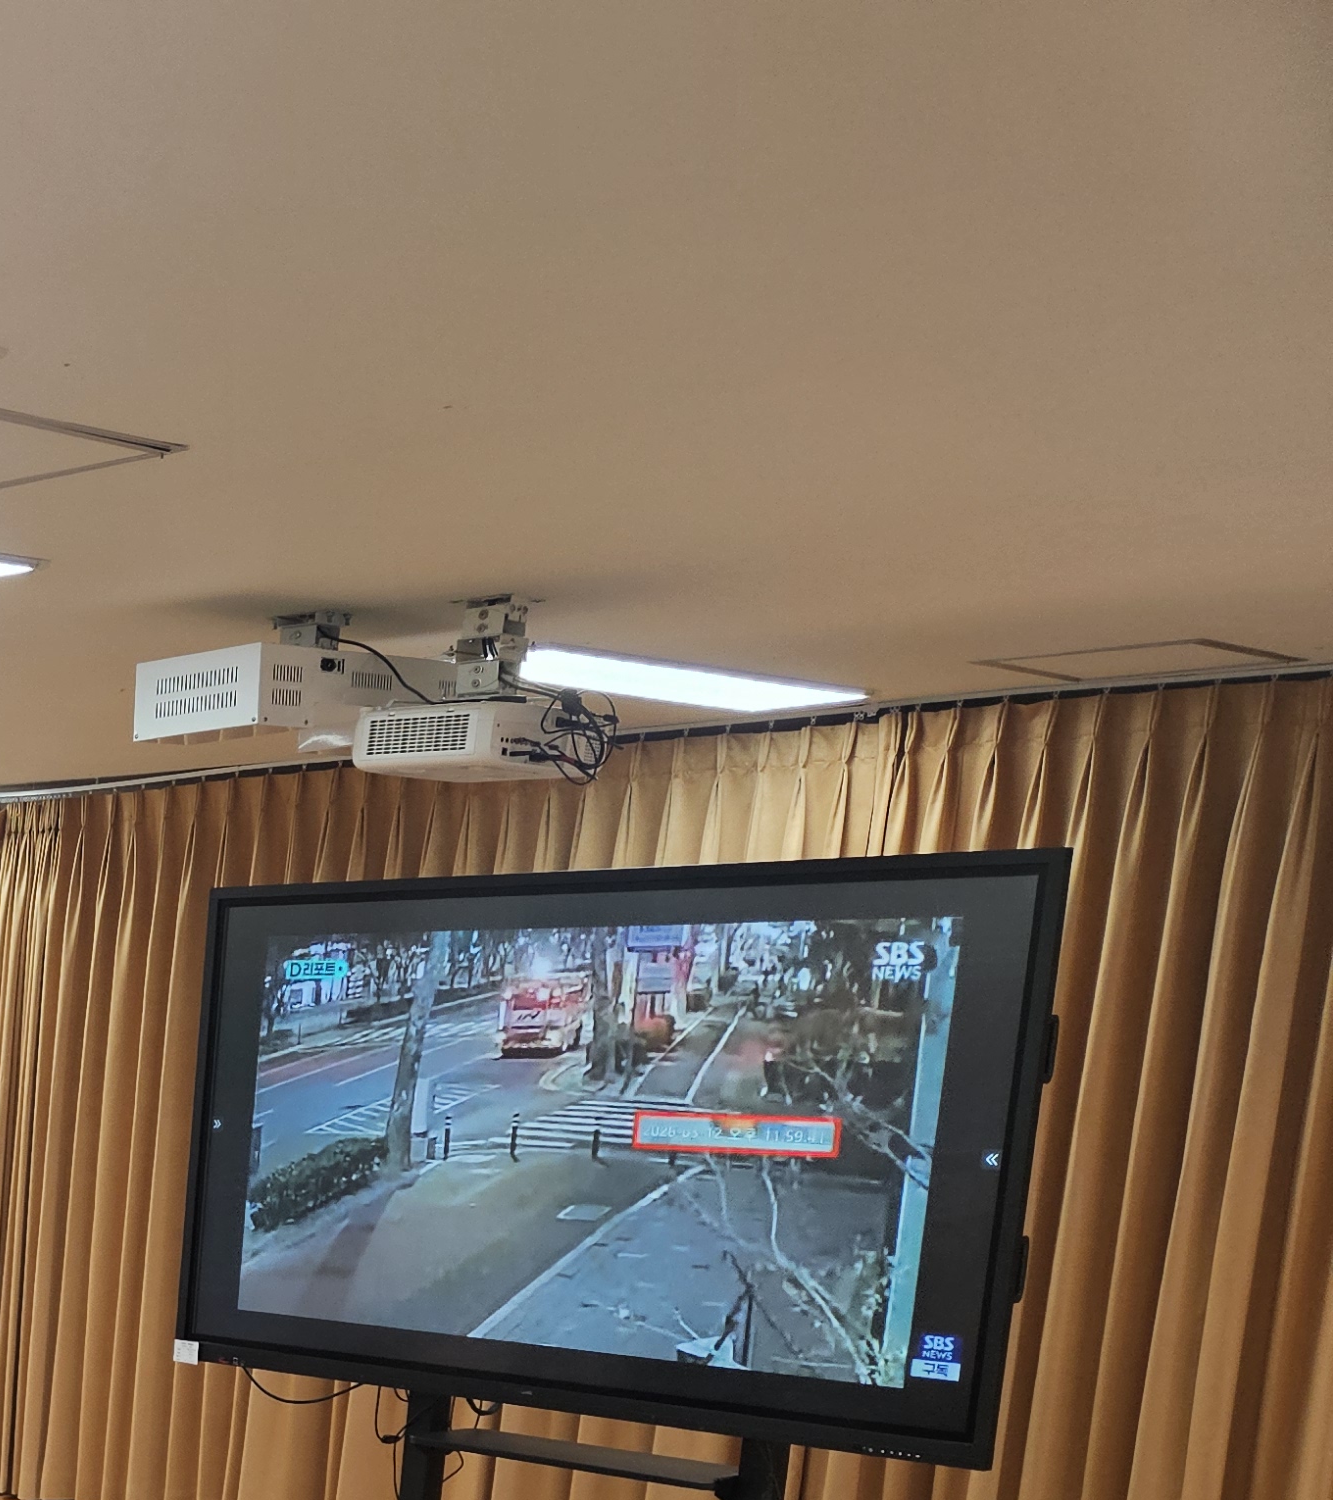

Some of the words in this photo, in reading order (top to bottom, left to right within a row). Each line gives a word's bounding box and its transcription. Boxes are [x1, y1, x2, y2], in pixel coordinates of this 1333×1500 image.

[873, 941, 925, 966] SBS
[289, 962, 336, 977] D리포트
[872, 965, 922, 983] NEWS
[923, 1334, 955, 1351] SBS
[922, 1350, 953, 1361] NEWS
[923, 1362, 949, 1377] 구독
